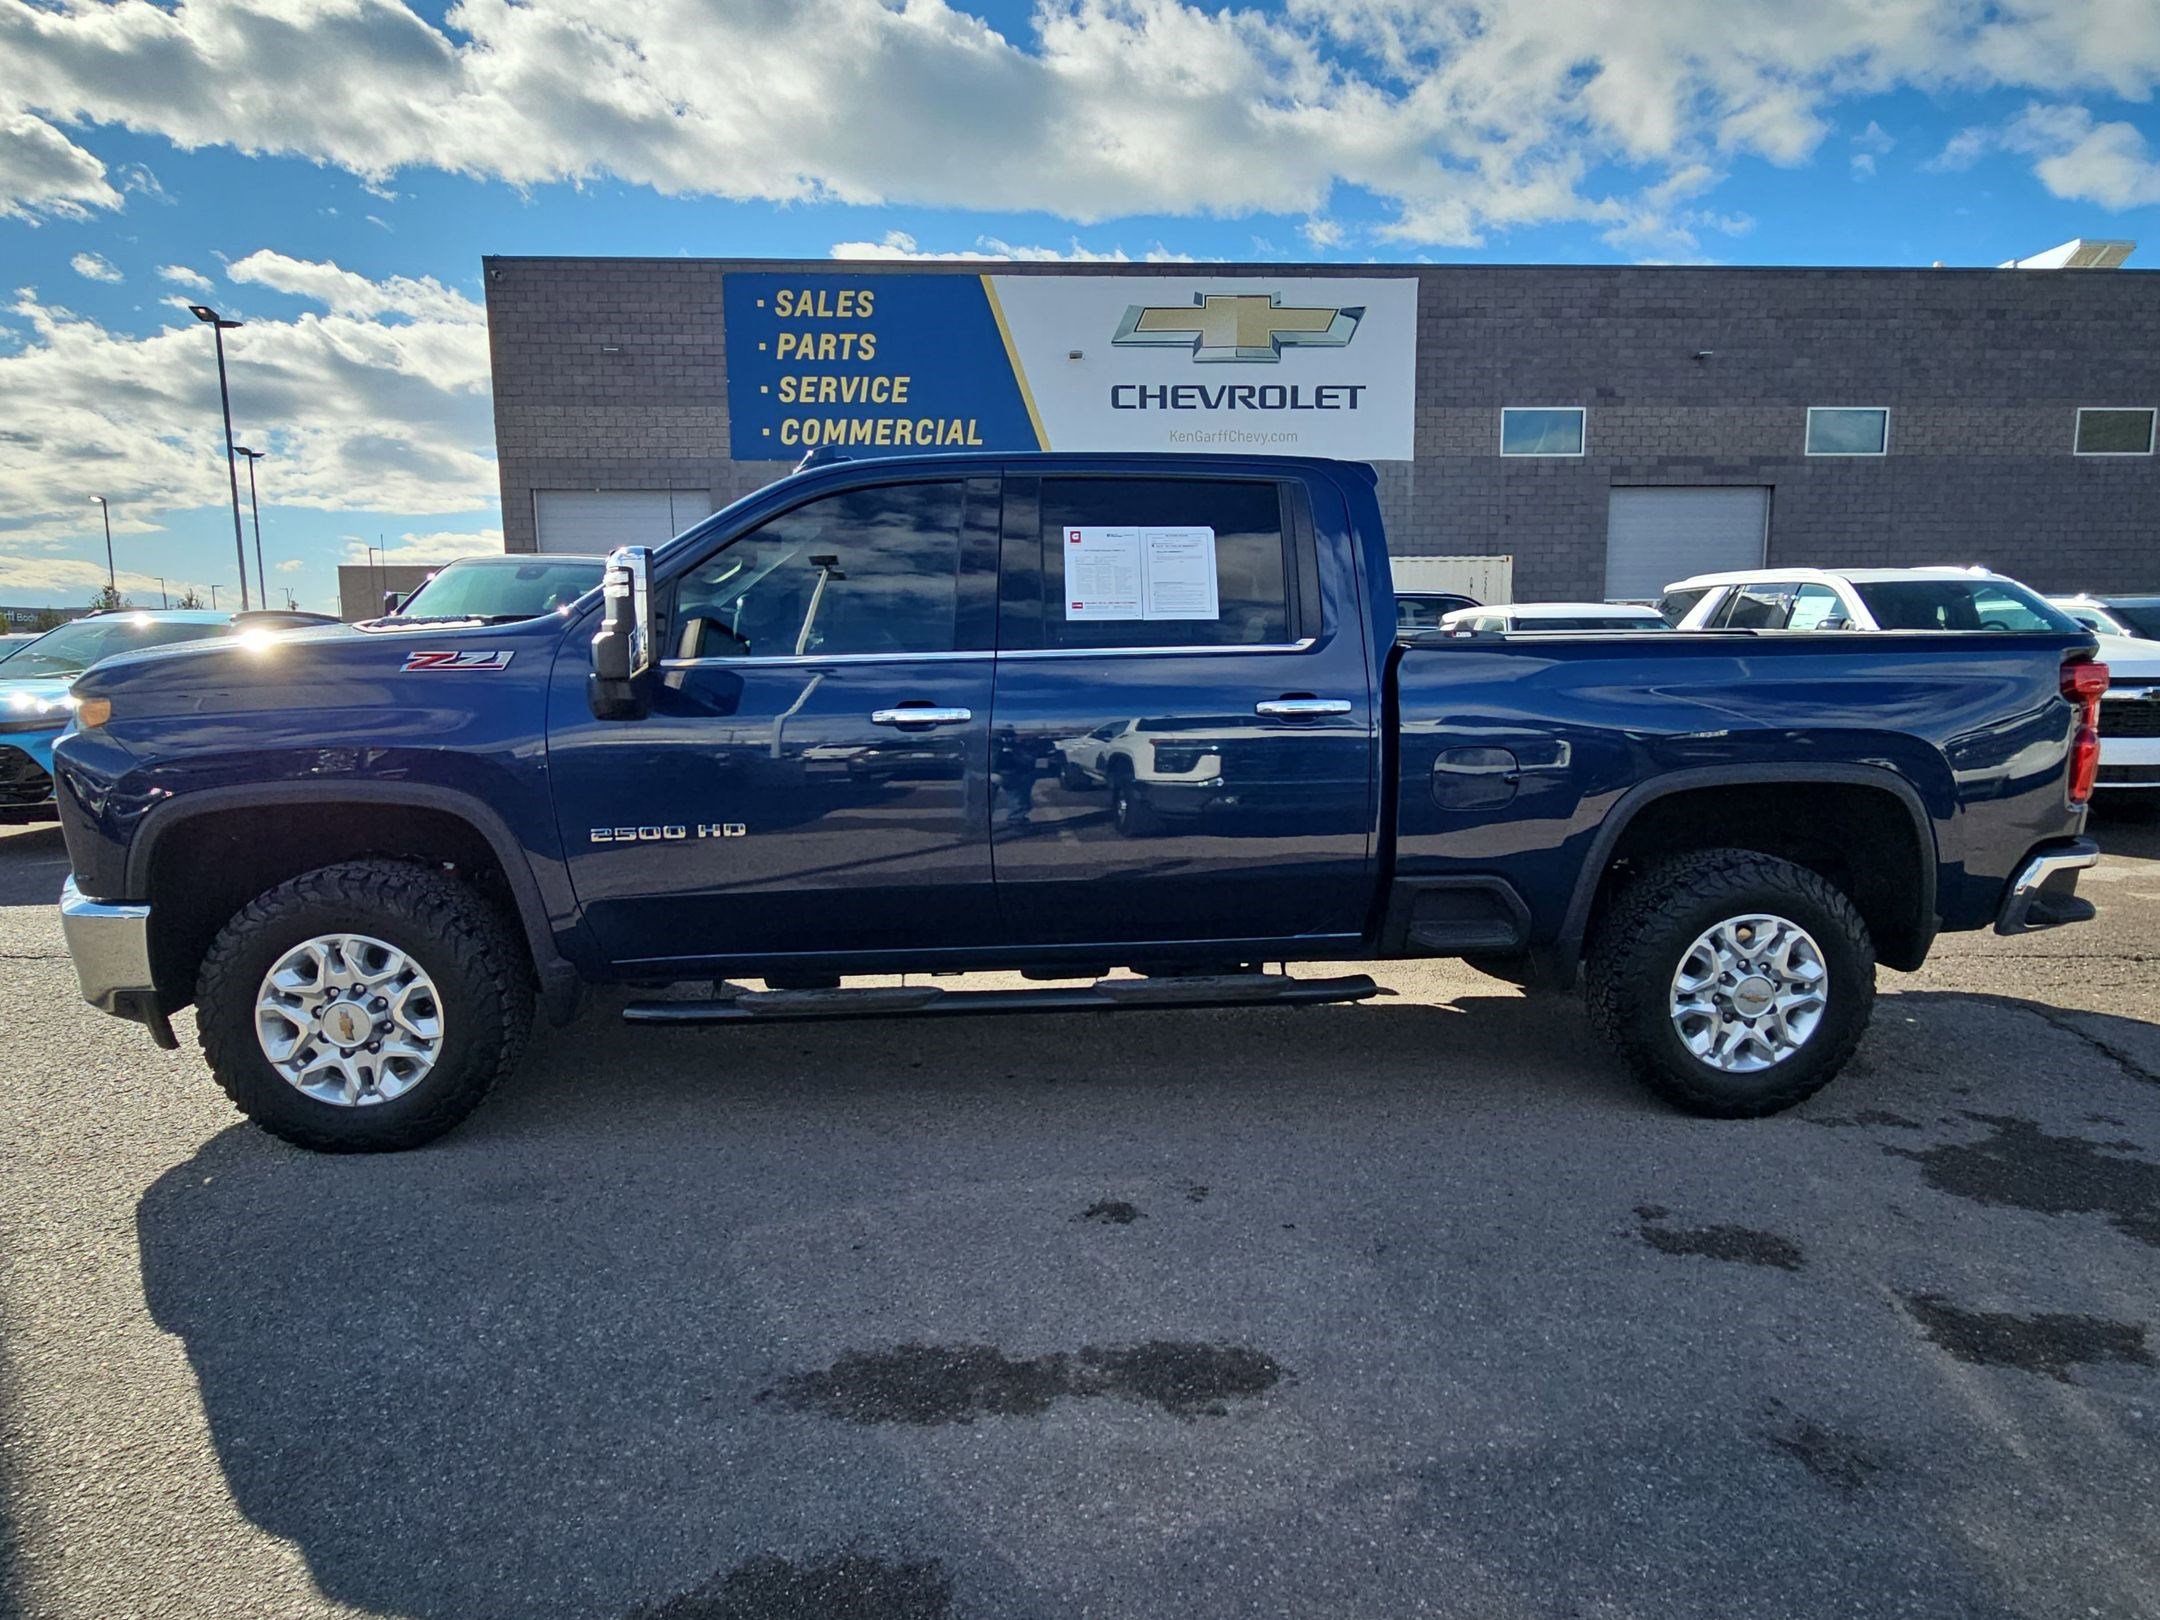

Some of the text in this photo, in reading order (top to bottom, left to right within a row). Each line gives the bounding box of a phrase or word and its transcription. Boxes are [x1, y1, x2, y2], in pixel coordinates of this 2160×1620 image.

[774, 289, 875, 318] SALES
[776, 332, 877, 360] PARTS
[778, 376, 911, 404] SERVICE
[1110, 384, 1367, 410] CHEVROLET
[780, 418, 984, 446] COMMERCIAL
[1168, 429, 1299, 446] KenGarffChevy.com
[400, 651, 515, 672] Z71
[590, 823, 746, 843] 2500 HD
